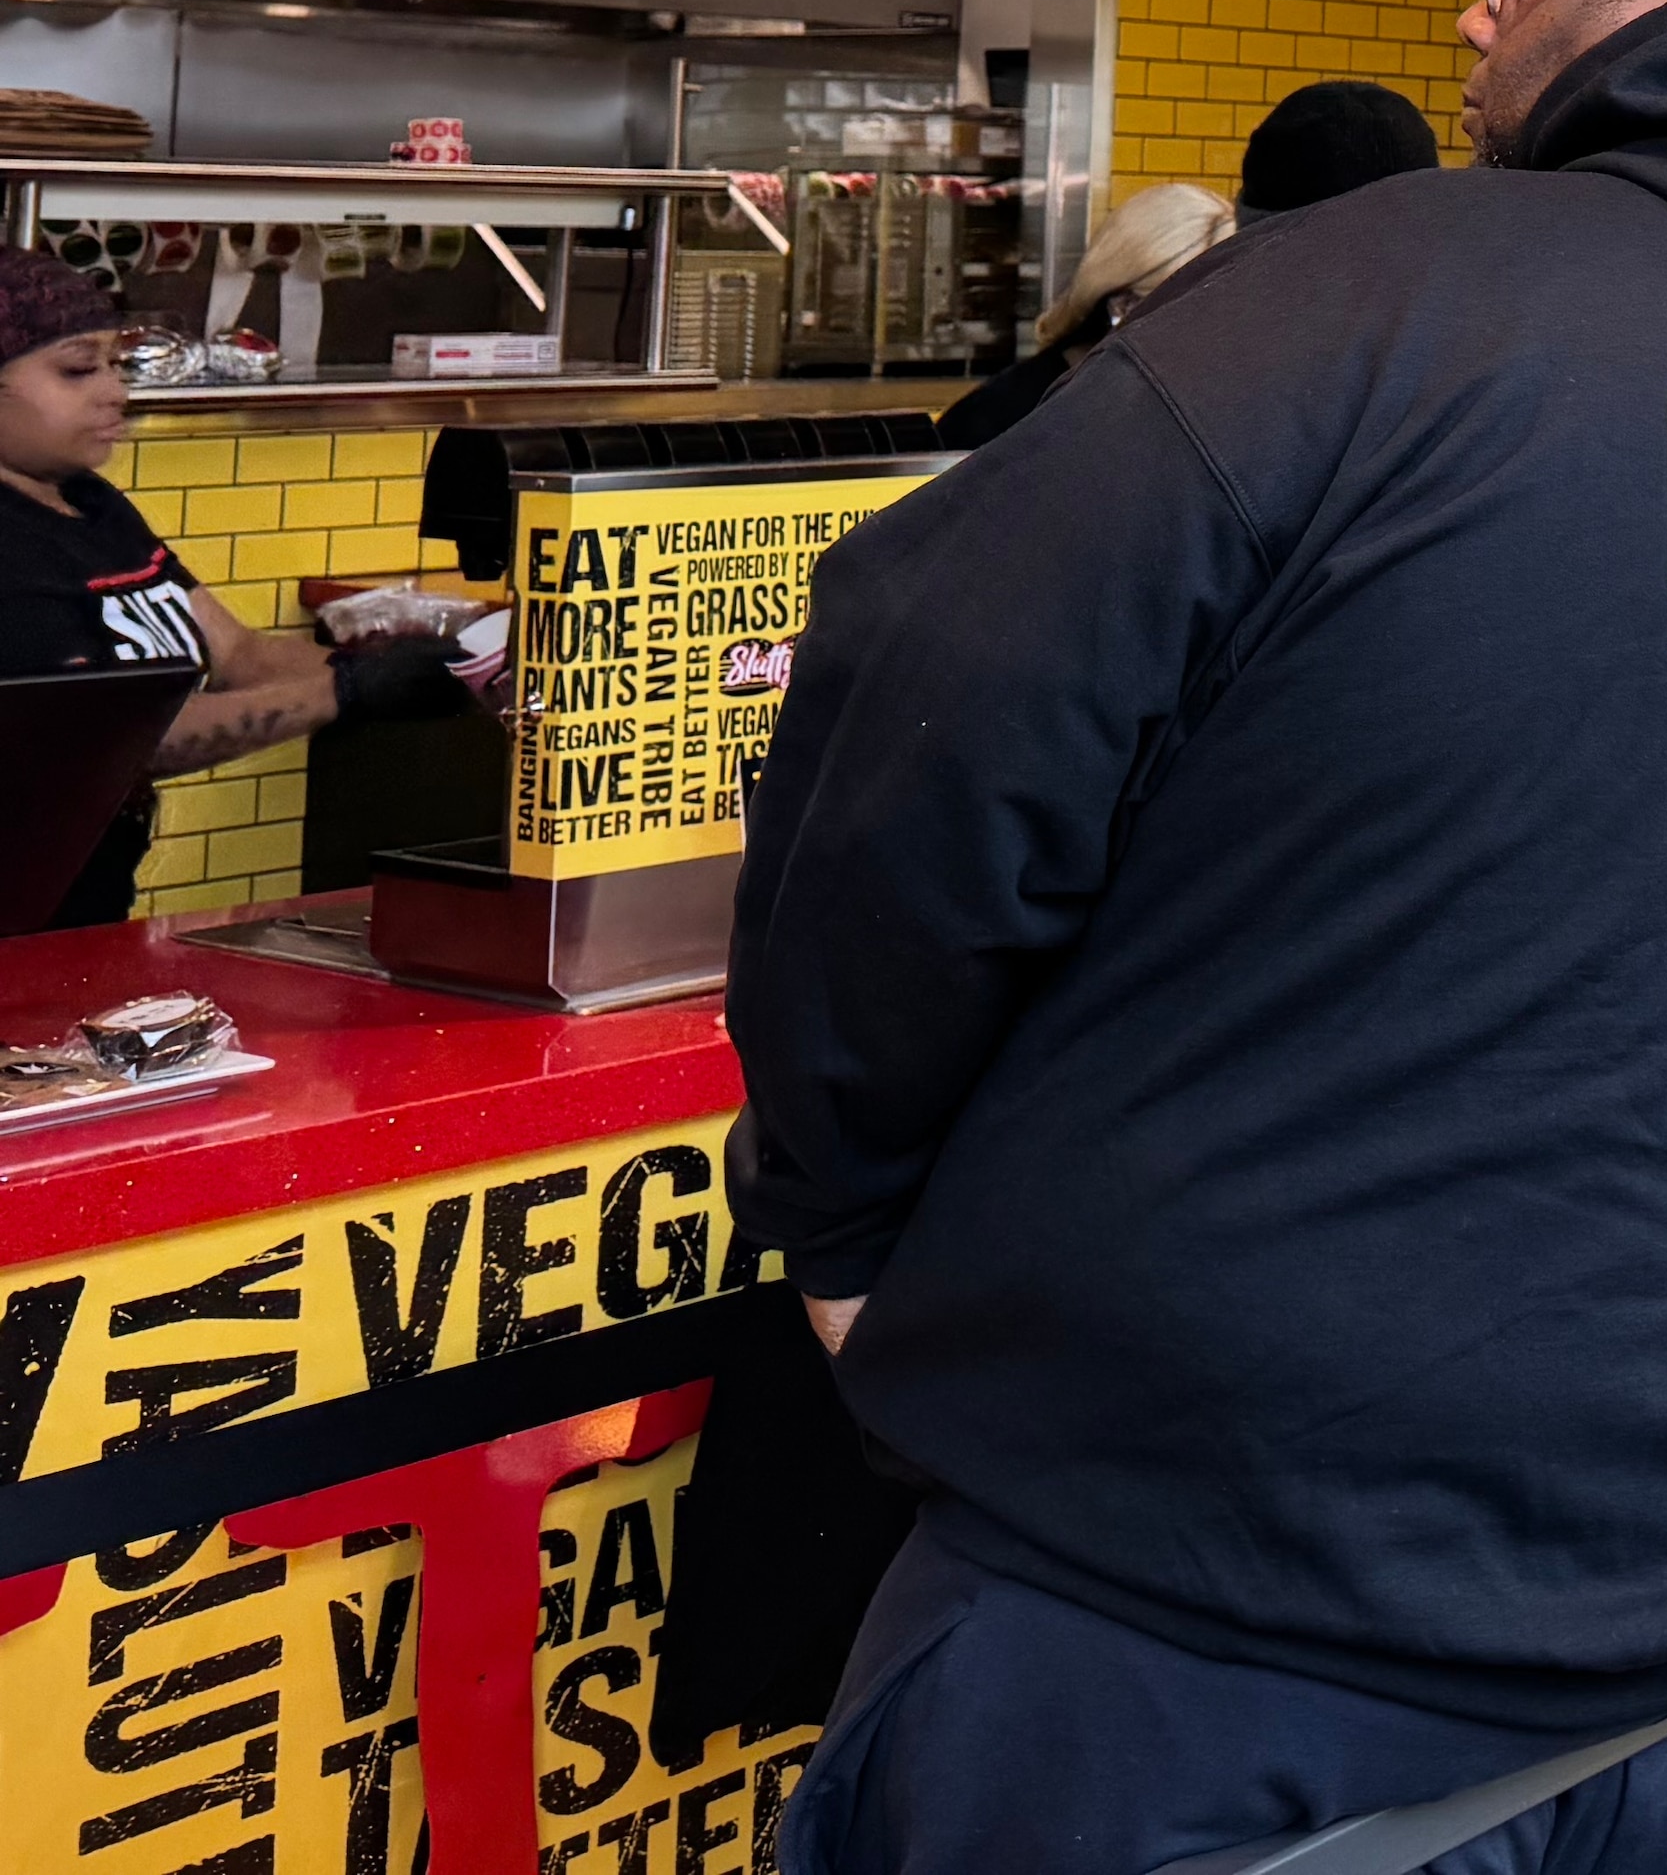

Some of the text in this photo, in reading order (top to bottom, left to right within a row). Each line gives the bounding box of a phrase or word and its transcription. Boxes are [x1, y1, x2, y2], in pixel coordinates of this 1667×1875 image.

[527, 524, 650, 594] EAT
[656, 517, 737, 557] VEGAN
[740, 515, 786, 550] FOR
[791, 511, 833, 547] THE
[686, 553, 765, 586] POWERED
[769, 551, 790, 578] BY
[525, 594, 641, 666] MORE
[685, 581, 789, 640] GRASS
[639, 563, 681, 834] VEGAN TRIBE
[543, 717, 637, 753] VEGANS
[679, 643, 711, 828] EAT BETTER
[540, 750, 636, 812] LIVE
[537, 809, 632, 846] BETTER
